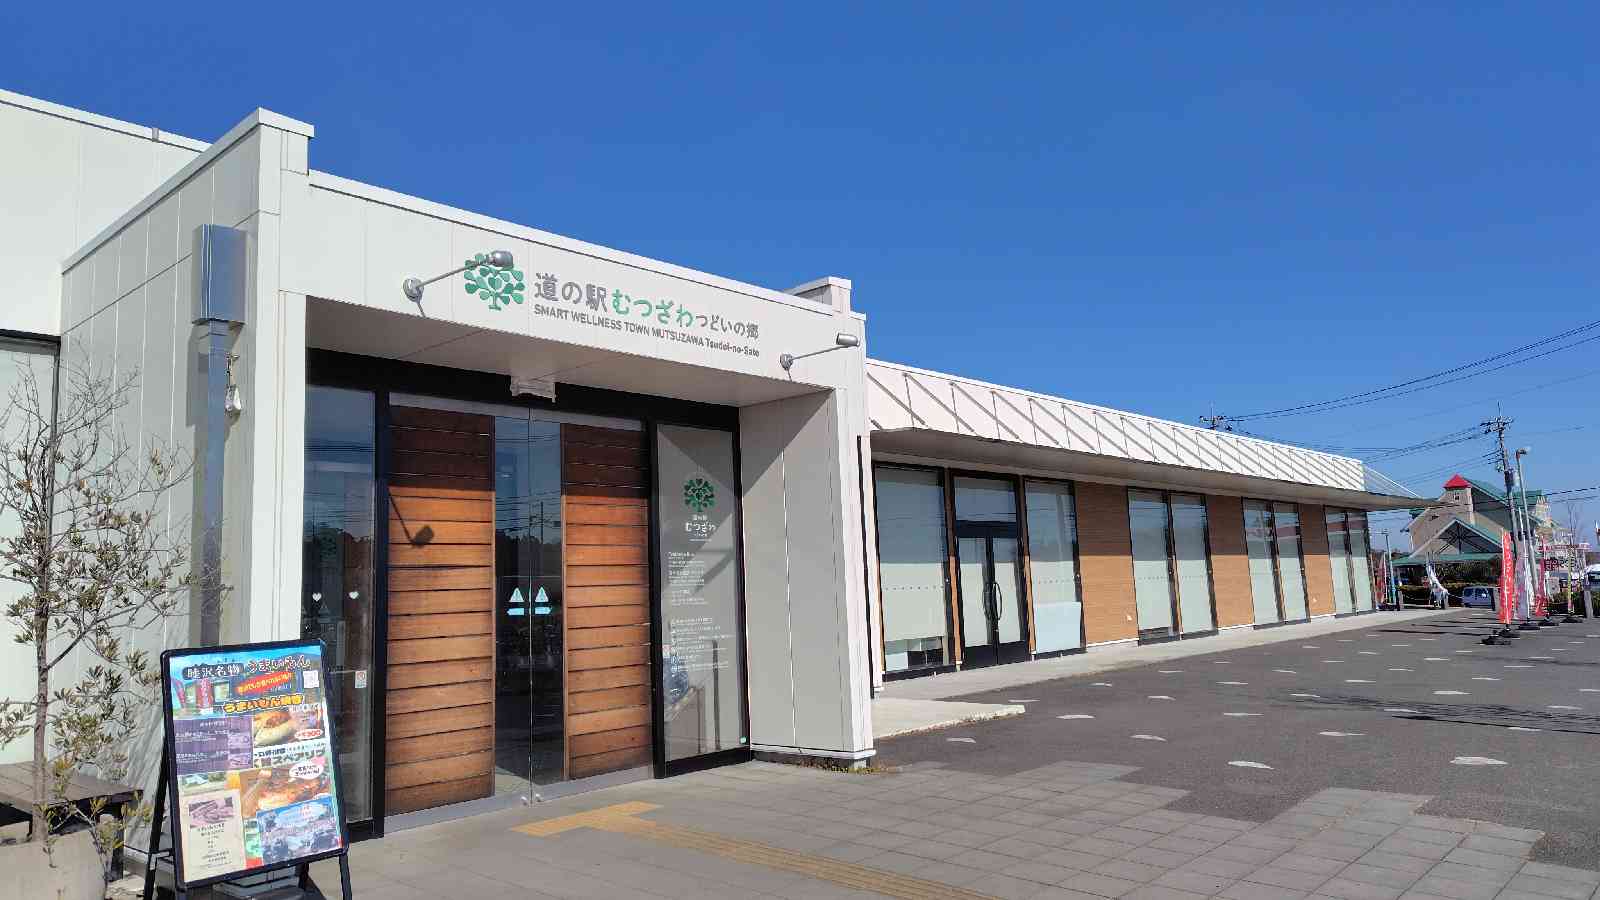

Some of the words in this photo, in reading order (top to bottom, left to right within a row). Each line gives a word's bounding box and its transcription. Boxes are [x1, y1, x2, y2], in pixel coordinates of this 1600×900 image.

[534, 304, 572, 320] SMART
[571, 311, 622, 330] WELLNESS
[624, 321, 650, 337] TOWN
[652, 327, 704, 347] MUTSUZAWA
